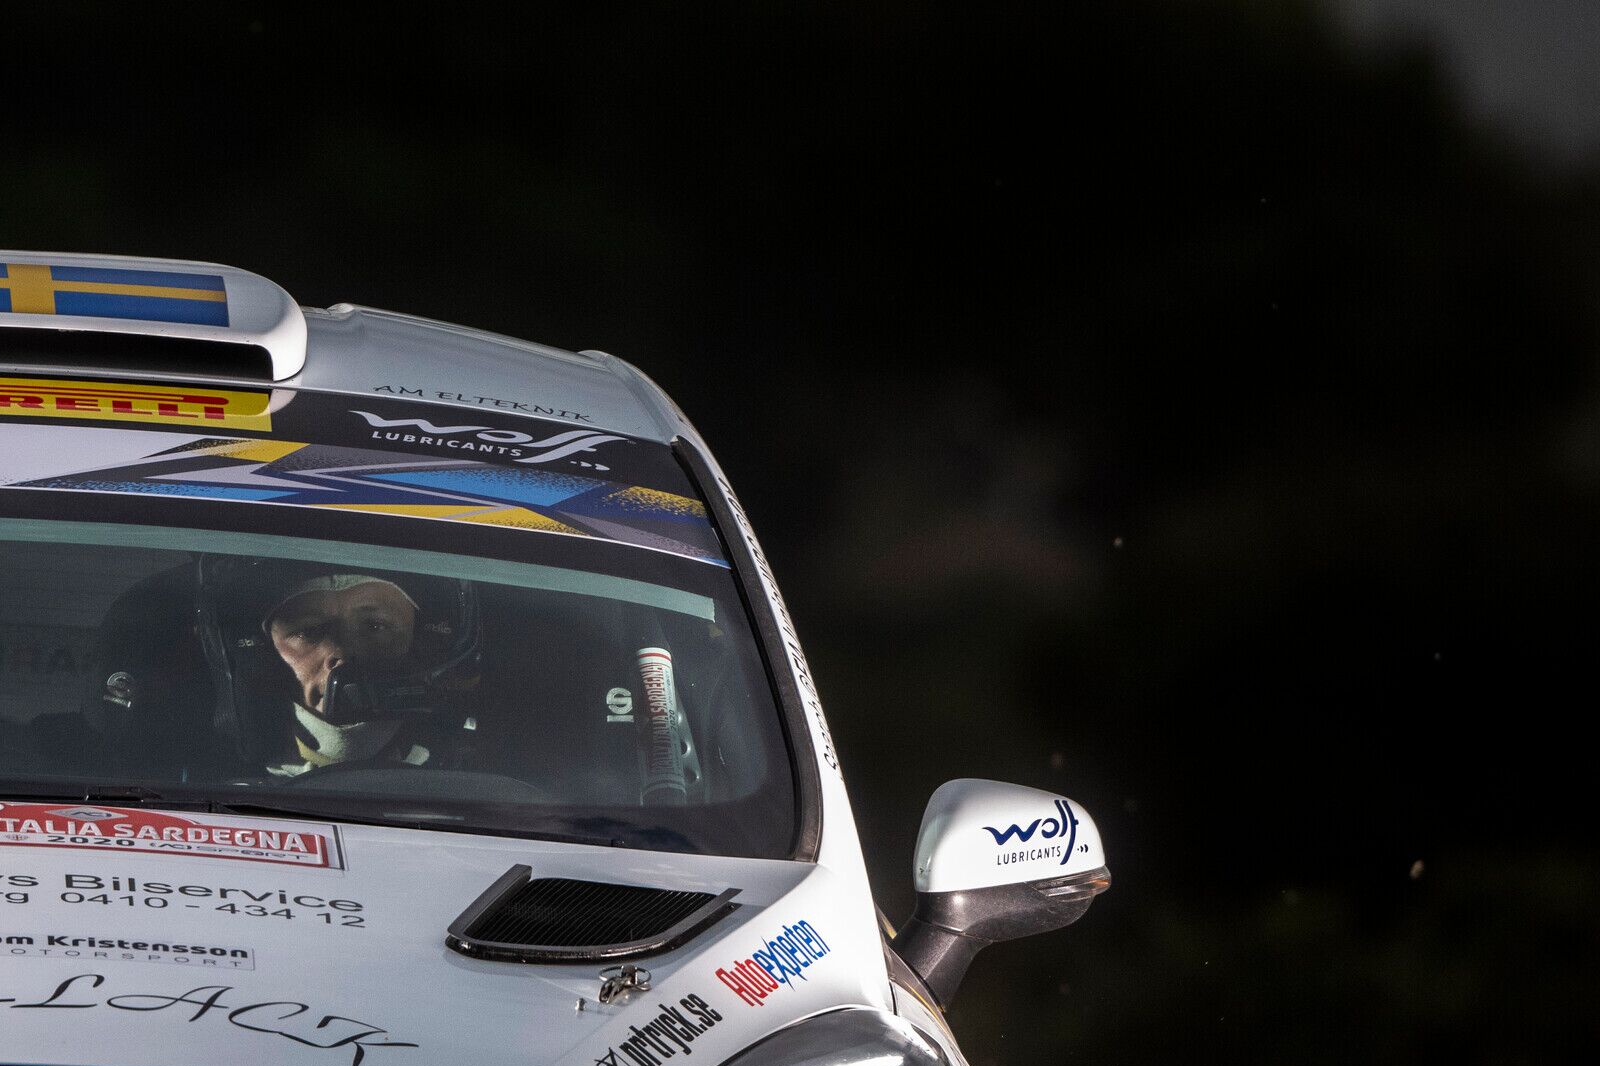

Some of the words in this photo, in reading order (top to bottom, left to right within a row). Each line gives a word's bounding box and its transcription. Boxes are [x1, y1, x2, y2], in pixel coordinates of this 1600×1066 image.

[372, 384, 423, 397] AM
[434, 391, 594, 423] ELTEKNIK
[371, 430, 523, 458] LUBRICANTS
[47, 835, 136, 847] 2020
[113, 822, 309, 854] SARDEGNA
[996, 845, 1062, 867] LUBRICANTS
[64, 873, 366, 911] Bilservice
[60, 892, 169, 908] 0410
[216, 903, 296, 921] 434
[317, 913, 367, 928] 12
[47, 935, 248, 958] Kristensson
[713, 918, 832, 1007] Autoexperten
